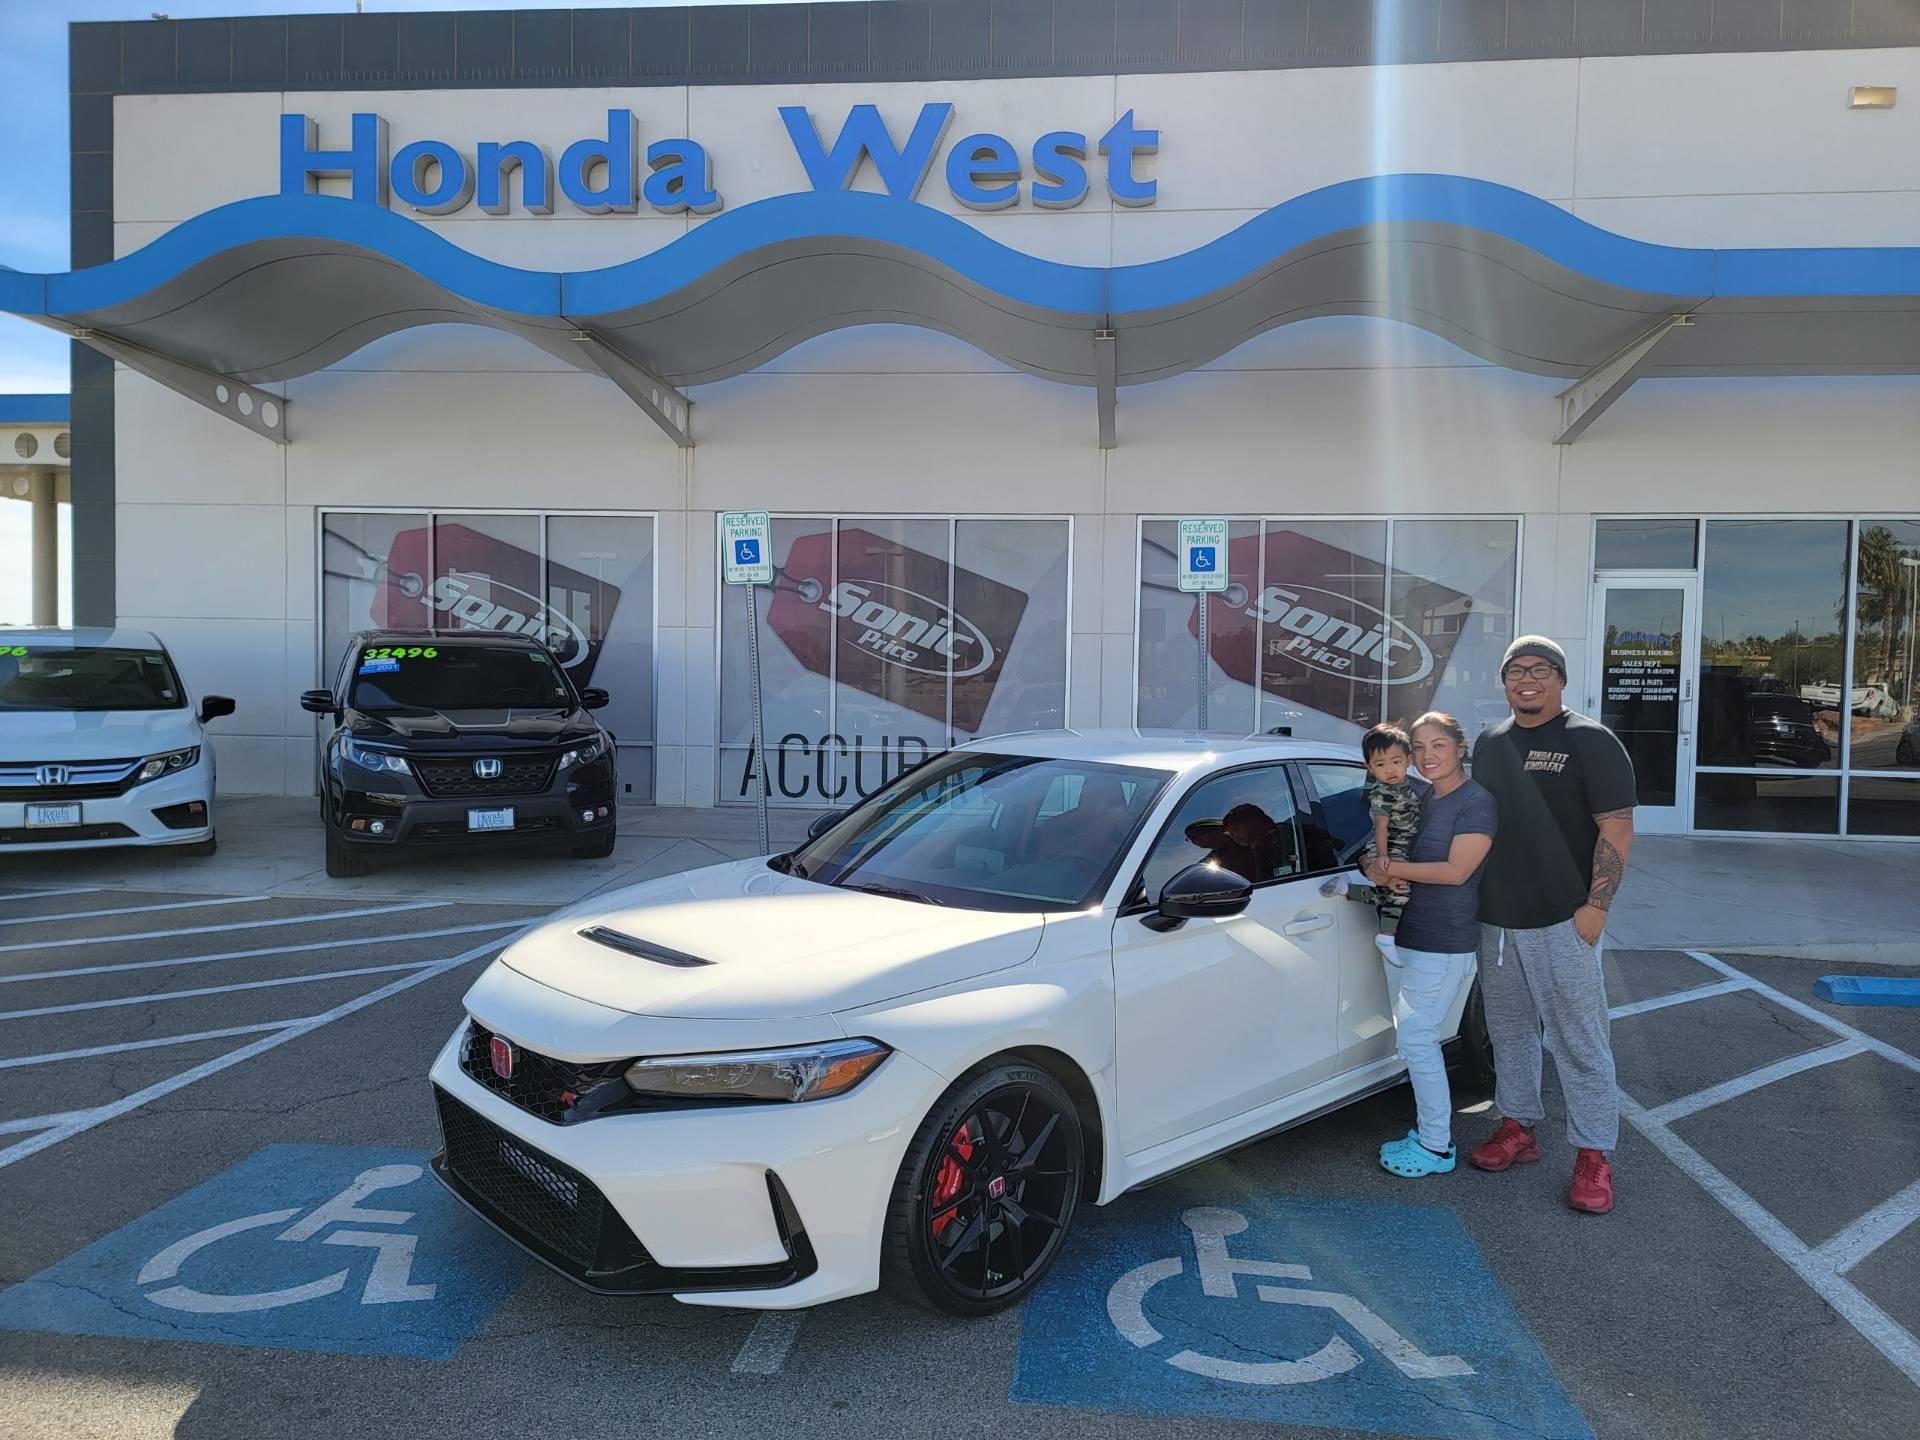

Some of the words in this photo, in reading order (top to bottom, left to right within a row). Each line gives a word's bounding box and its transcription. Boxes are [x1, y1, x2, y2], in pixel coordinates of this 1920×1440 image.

[280, 108, 723, 217] Honda
[778, 103, 1159, 212] West
[725, 516, 766, 527] RESERVED
[730, 528, 763, 538] PARKING
[1182, 523, 1224, 534] RESERVED
[1186, 535, 1221, 545] PARKING
[818, 582, 976, 660] Sonic
[1244, 586, 1414, 667] Sonic
[856, 629, 919, 662] Price
[363, 647, 438, 660] 32496
[1284, 635, 1352, 670] Price
[1551, 752, 1569, 763] FIT
[1548, 762, 1565, 773] FAT
